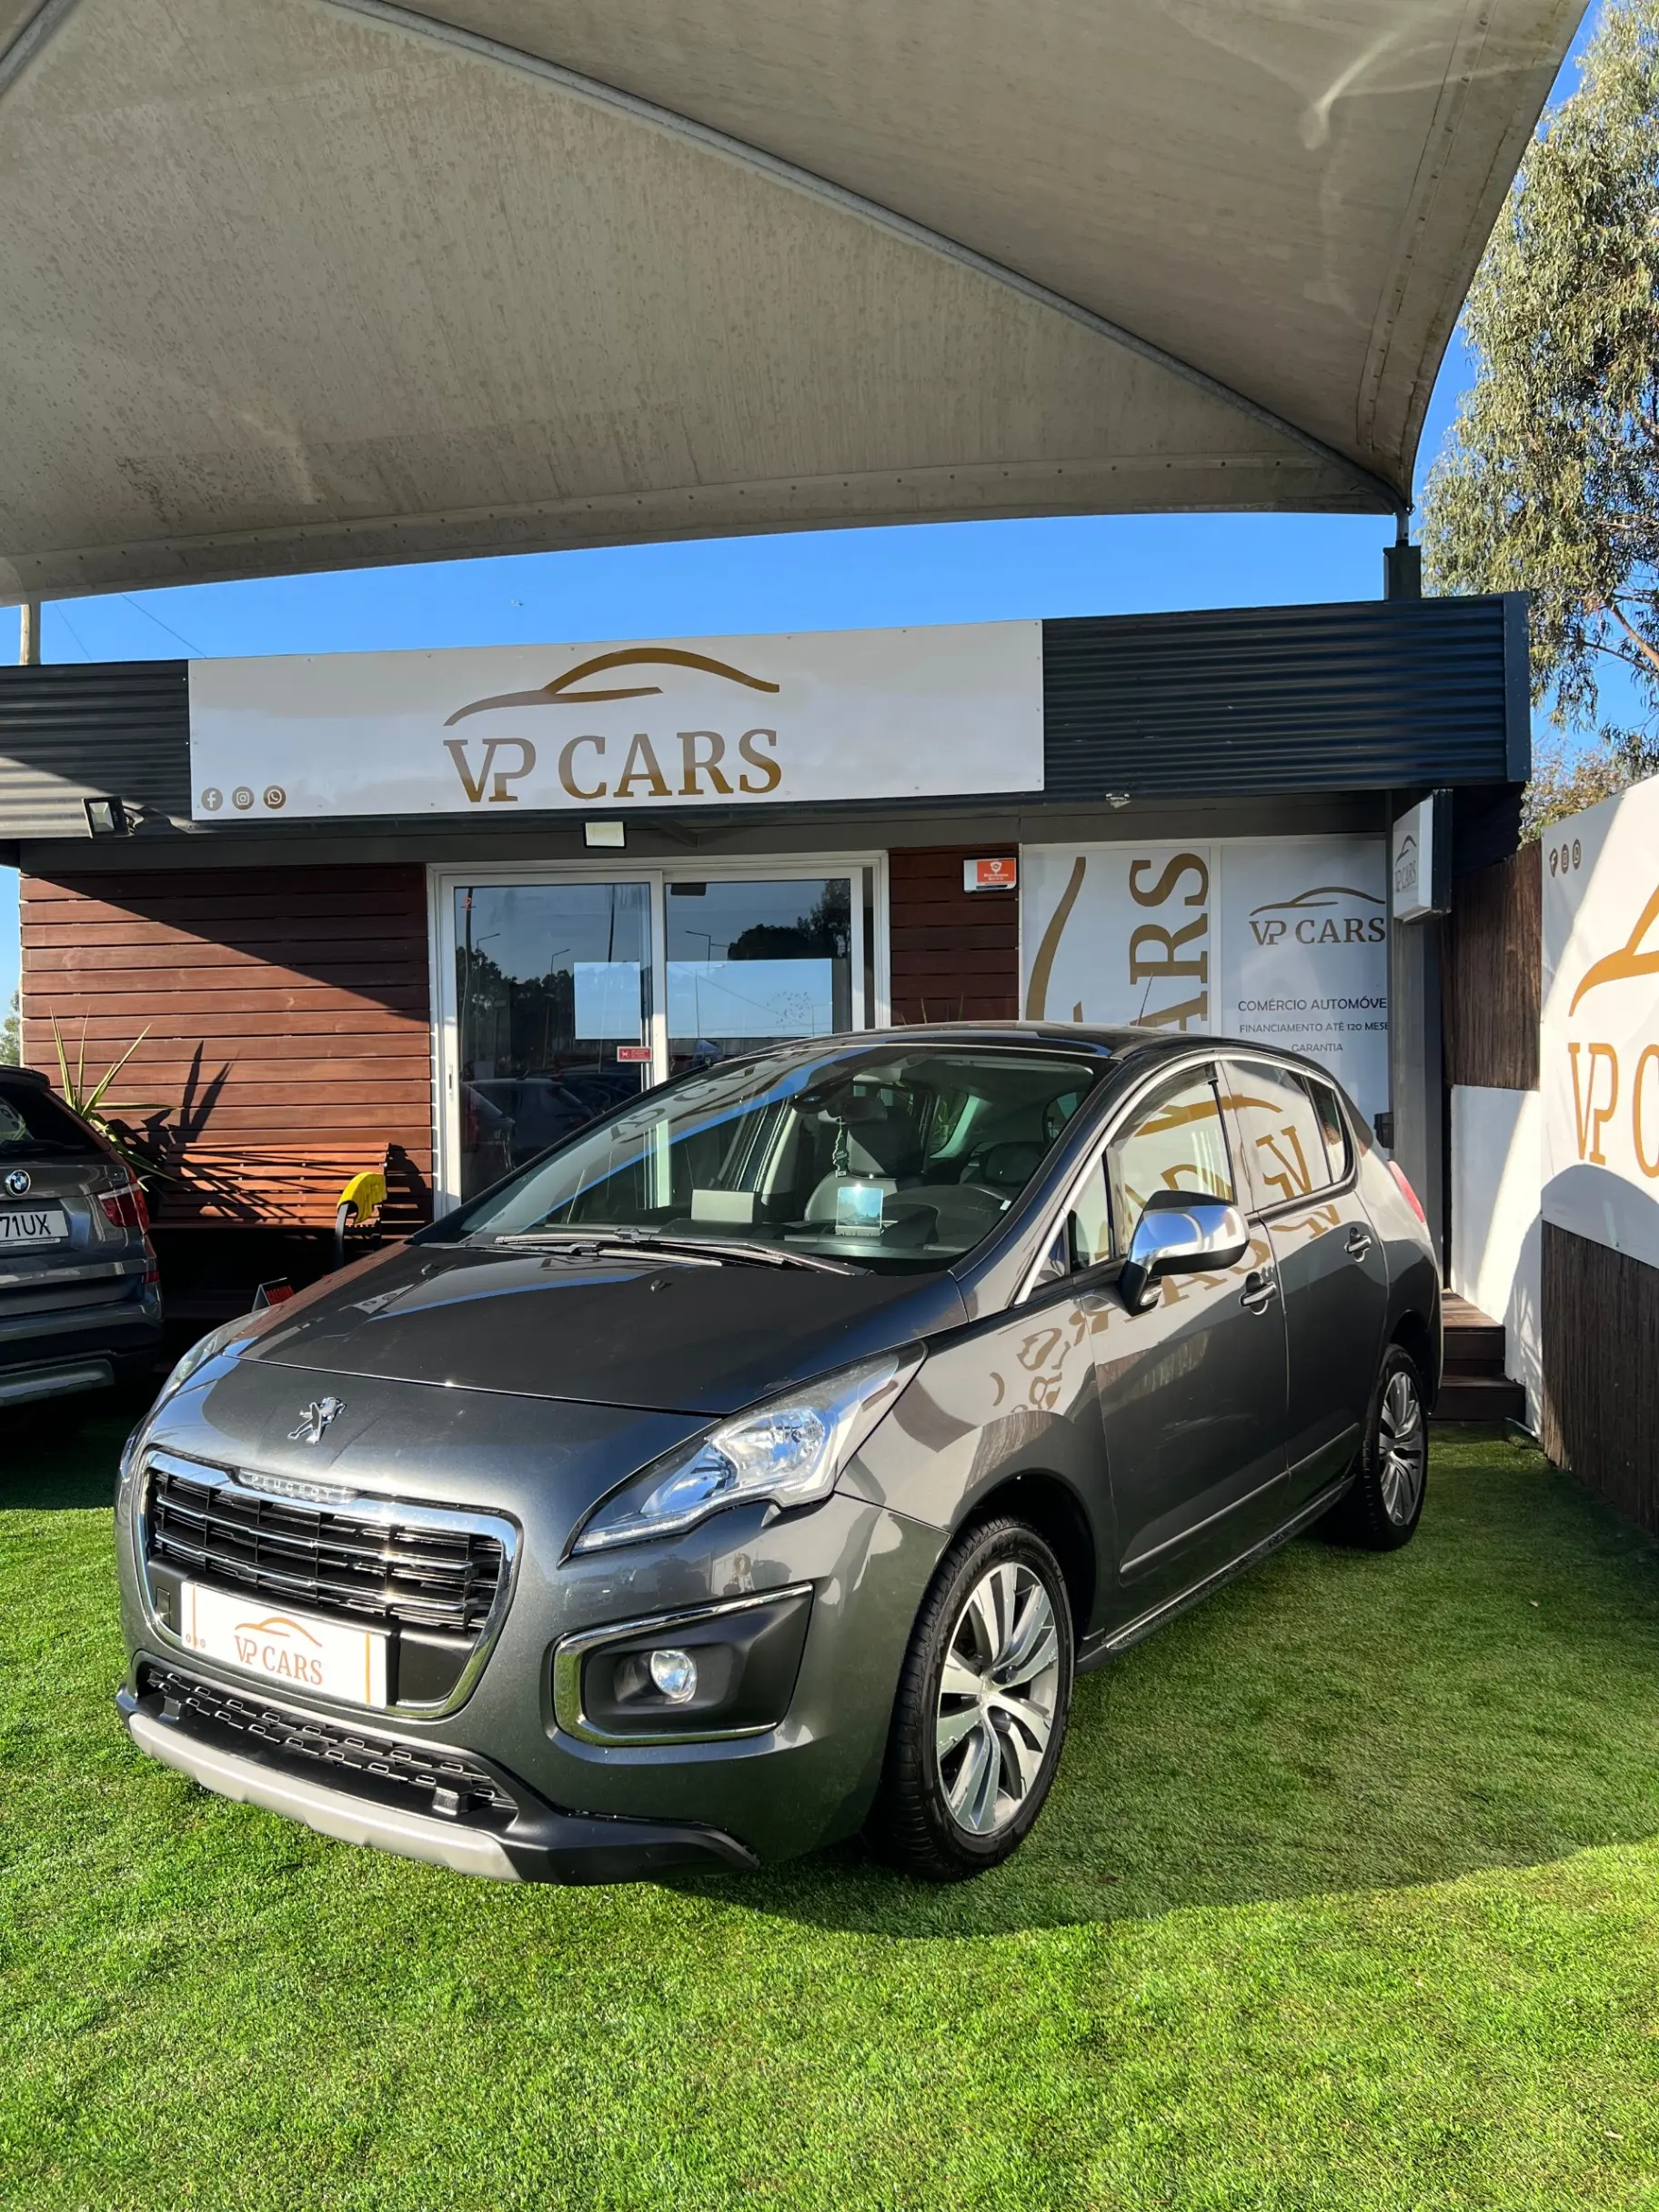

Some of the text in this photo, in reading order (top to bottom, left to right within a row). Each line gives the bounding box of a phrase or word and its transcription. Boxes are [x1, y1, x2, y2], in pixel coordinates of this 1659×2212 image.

[443, 729, 782, 803] VP CARS
[1249, 918, 1386, 945] VP CARS
[1238, 999, 1307, 1011] COMÉRCIO
[1239, 1023, 1323, 1033] FINANCIAMENTO
[1325, 1021, 1344, 1031] ATÉ
[1347, 1022, 1362, 1031] 120
[1292, 1043, 1343, 1052] GARANTIA
[1568, 1042, 1618, 1165] VP
[251, 1475, 330, 1499] PEUGEOT
[234, 1635, 323, 1685] VP CARS
